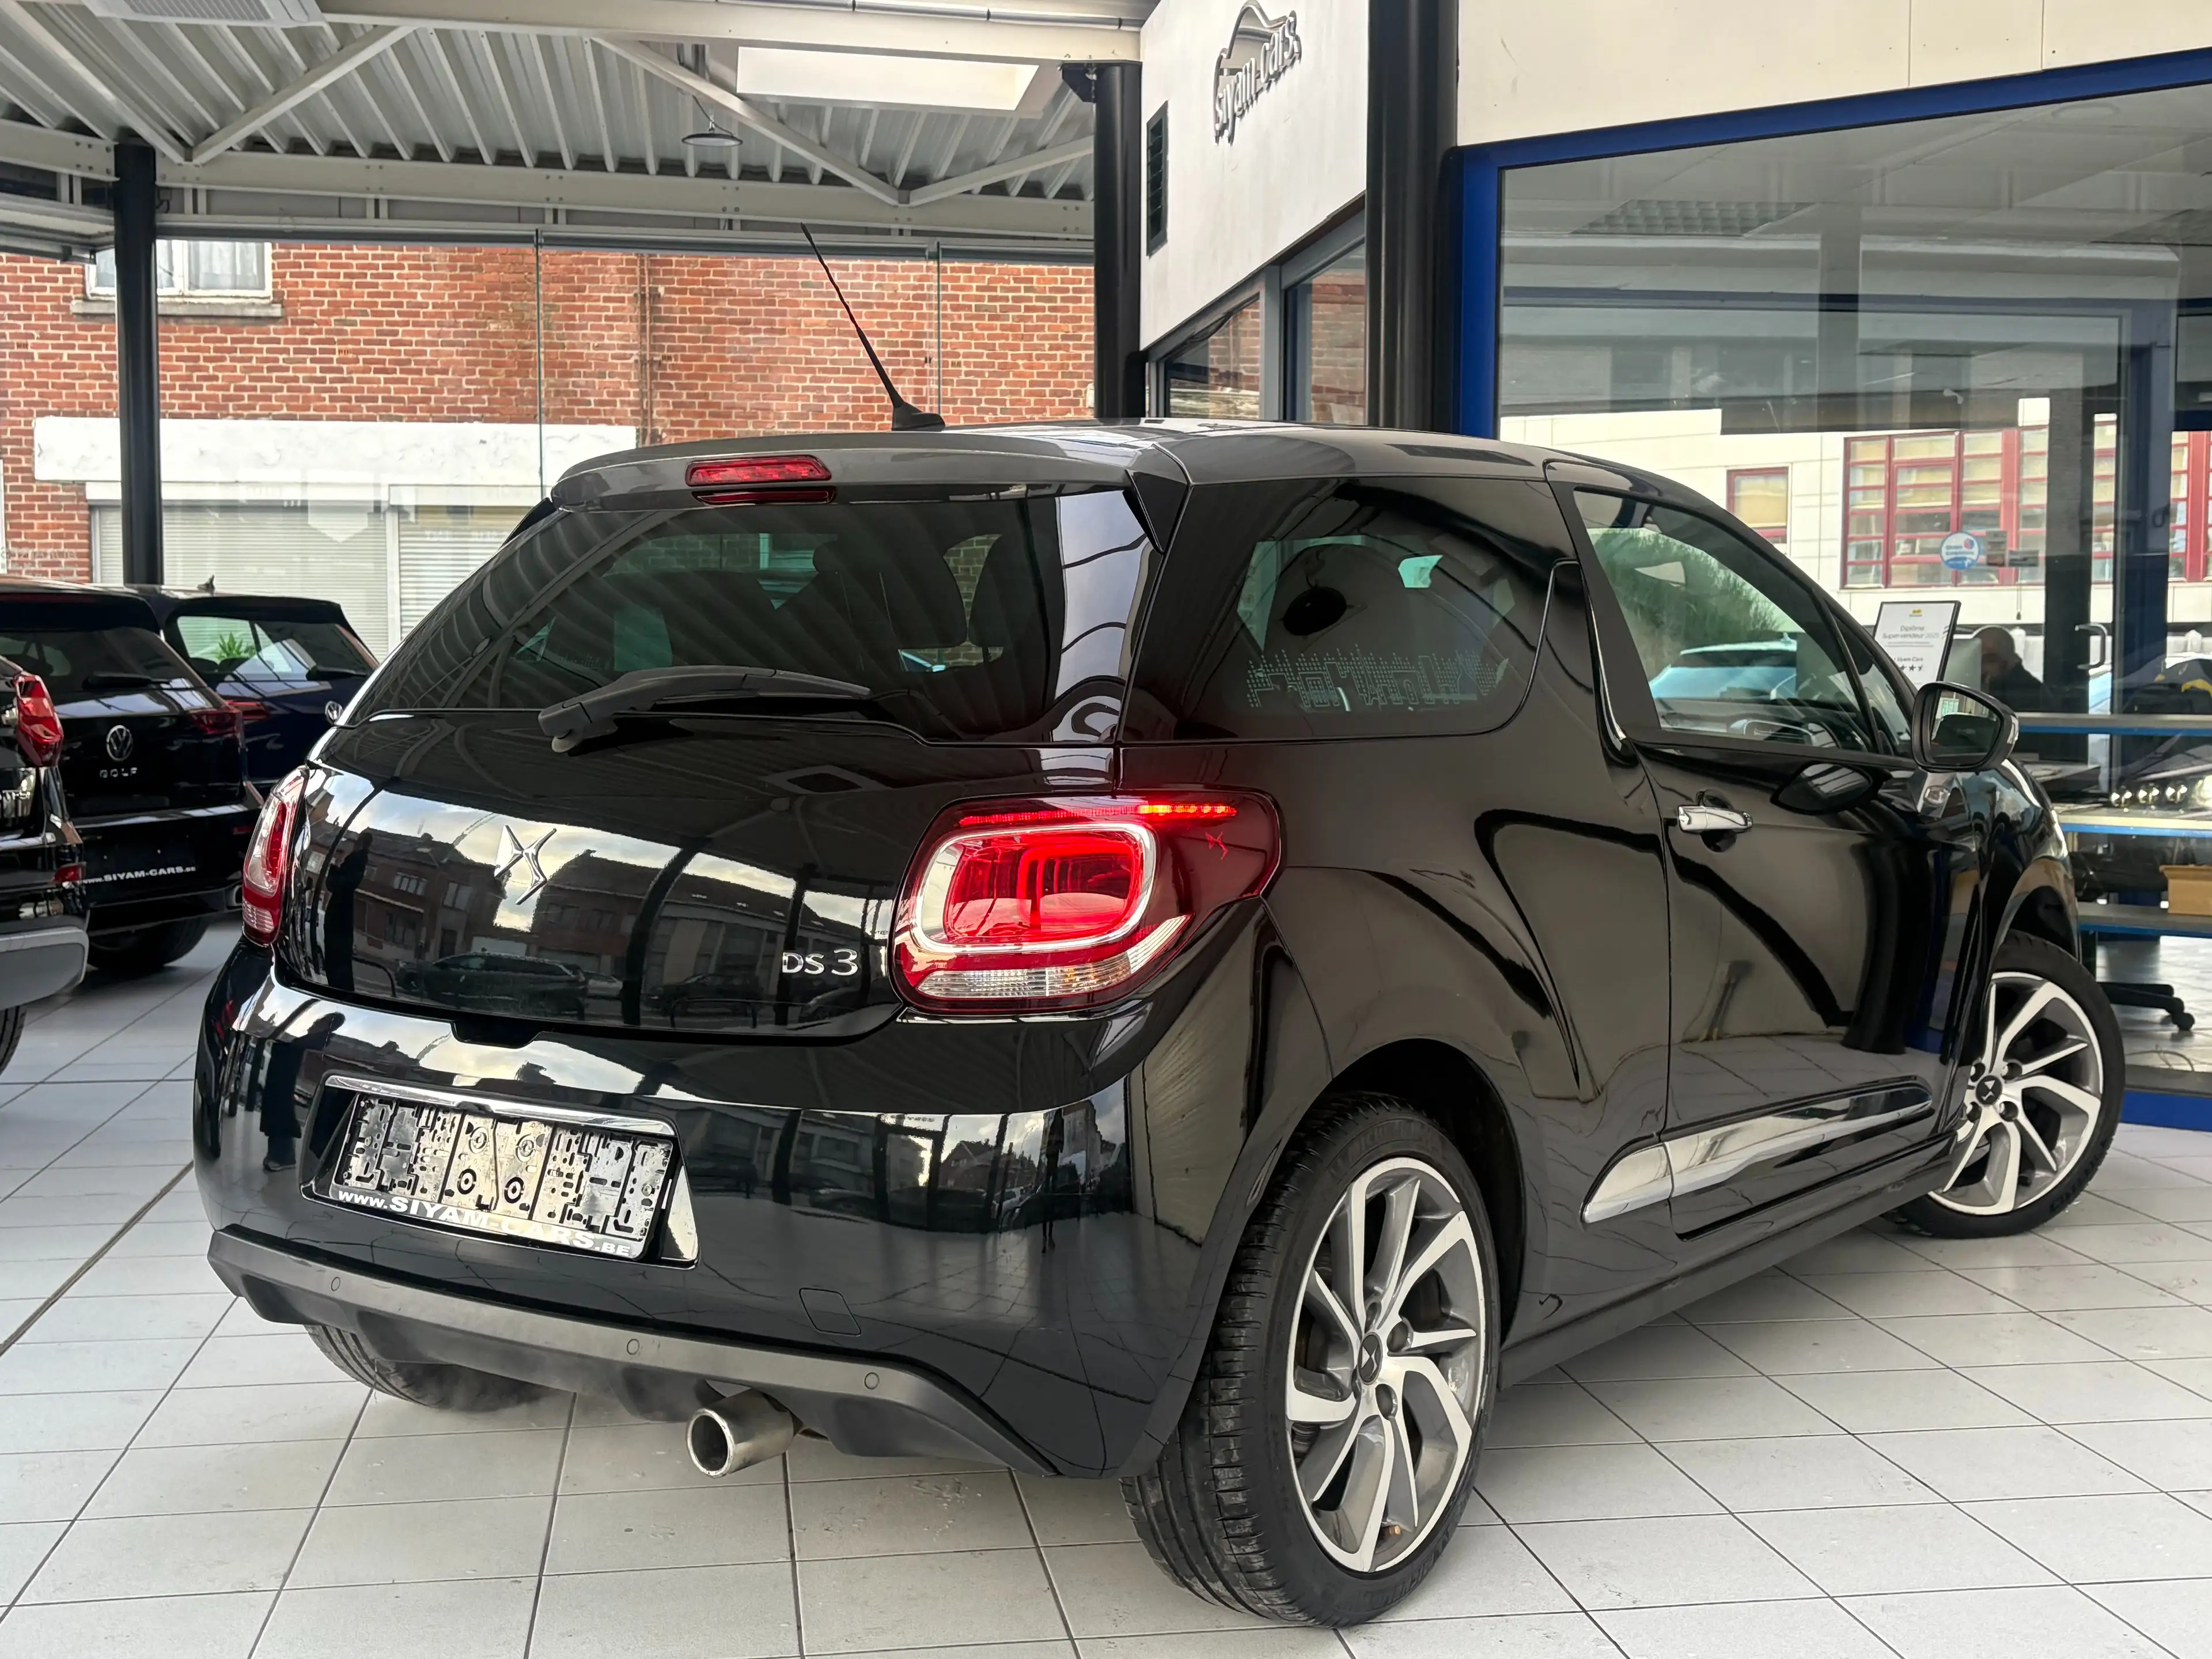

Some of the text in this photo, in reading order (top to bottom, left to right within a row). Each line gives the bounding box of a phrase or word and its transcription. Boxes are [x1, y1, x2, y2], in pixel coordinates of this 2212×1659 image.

[100, 767, 138, 778] GOLF
[782, 948, 858, 976] DS 3
[338, 1190, 631, 1257] www.SIYAM-CARS.BE
